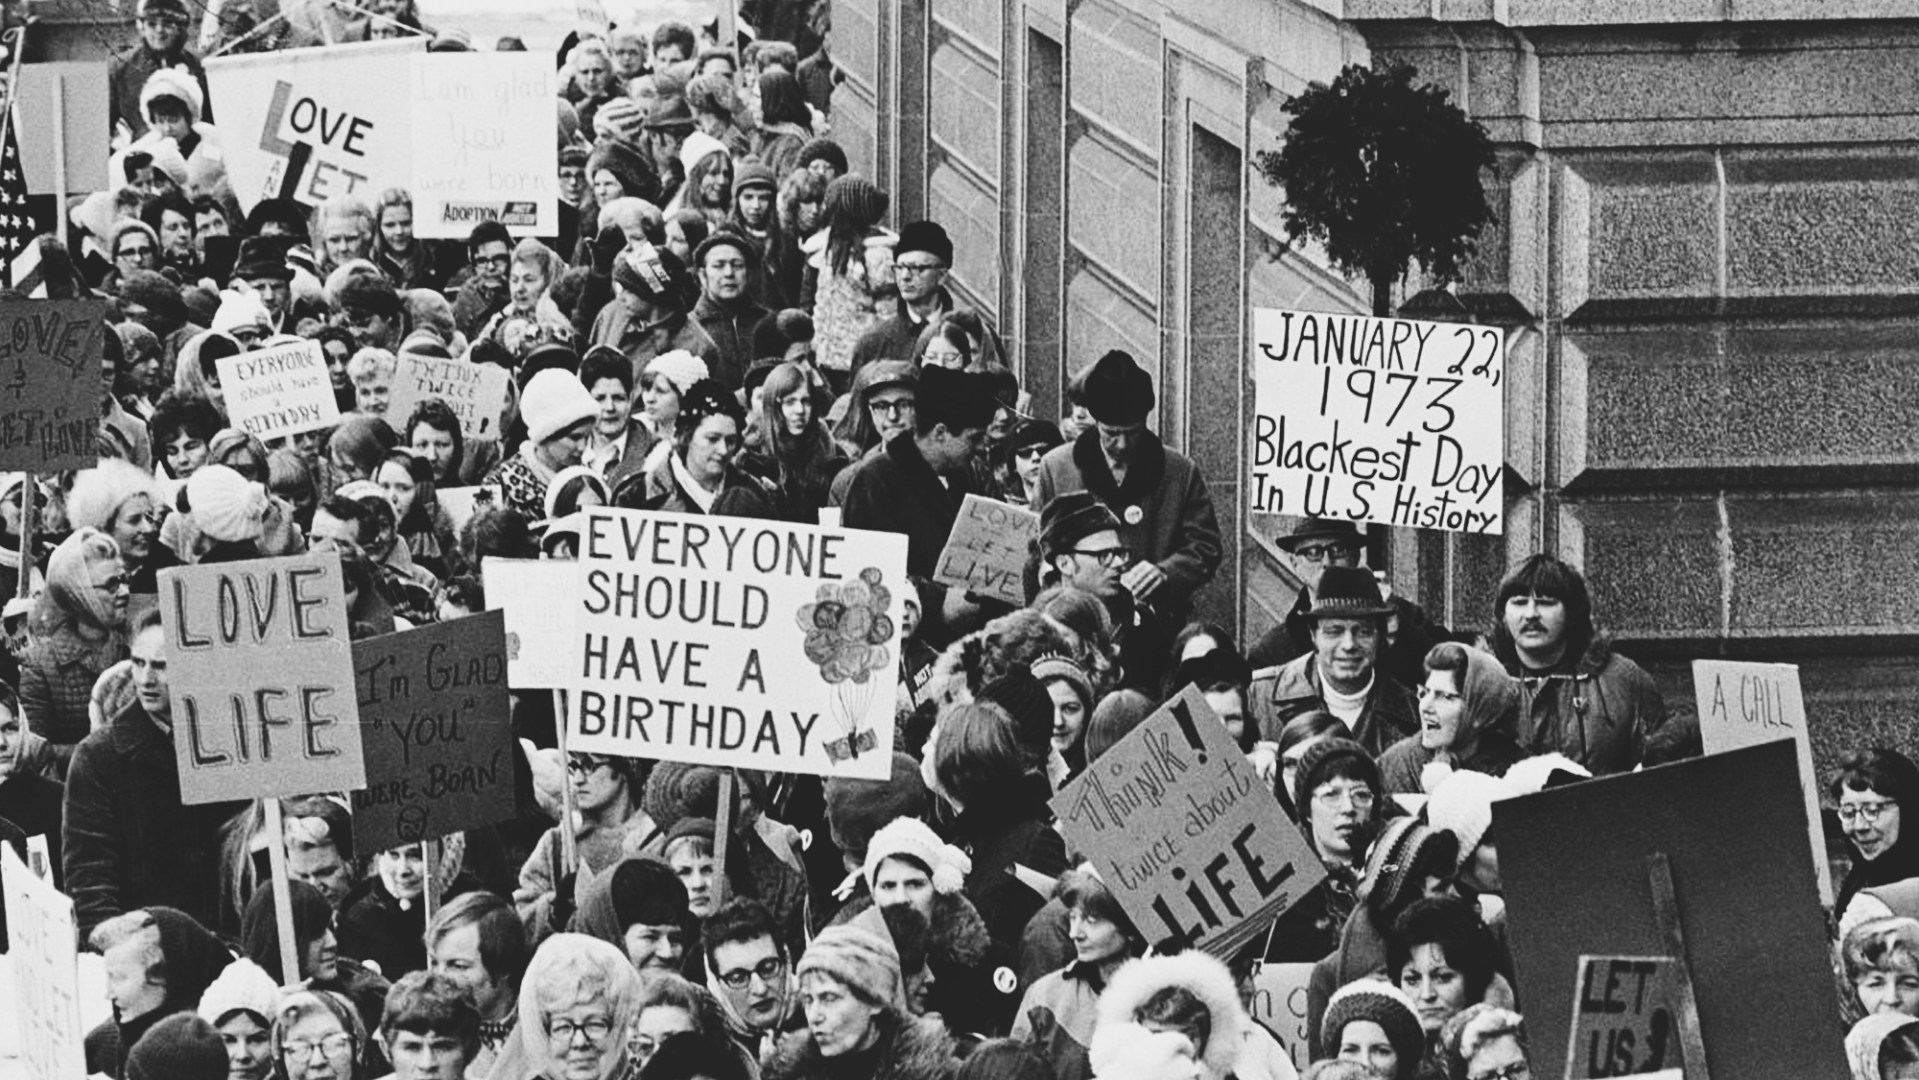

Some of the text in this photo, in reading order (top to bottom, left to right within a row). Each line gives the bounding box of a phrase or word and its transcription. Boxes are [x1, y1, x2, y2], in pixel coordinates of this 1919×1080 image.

[260, 80, 374, 157] LOVE
[414, 62, 549, 117] I am glad
[419, 161, 548, 192] were born
[235, 349, 316, 381] EVERYONE
[1259, 312, 1501, 388] JANUARY 22,
[415, 377, 475, 398] TWICE
[1320, 365, 1464, 434] 1973
[1254, 414, 1503, 505] Blackest Day
[1252, 472, 1285, 513] In
[1391, 484, 1499, 535] History
[588, 514, 845, 580] EVERYONE
[942, 556, 1021, 597] LIVE
[173, 564, 334, 651] LOVE
[583, 569, 770, 630] SHOULD
[426, 643, 502, 692] GLAD
[582, 633, 709, 689] HAVE
[736, 648, 766, 695] A
[183, 684, 342, 769] LIFE
[579, 690, 820, 757] BIRTHDAY
[1712, 673, 1794, 730] A CALL
[356, 779, 416, 810] WERE
[1184, 758, 1251, 837] about
[1580, 960, 1658, 1016] LET
[1587, 1027, 1637, 1079] US
